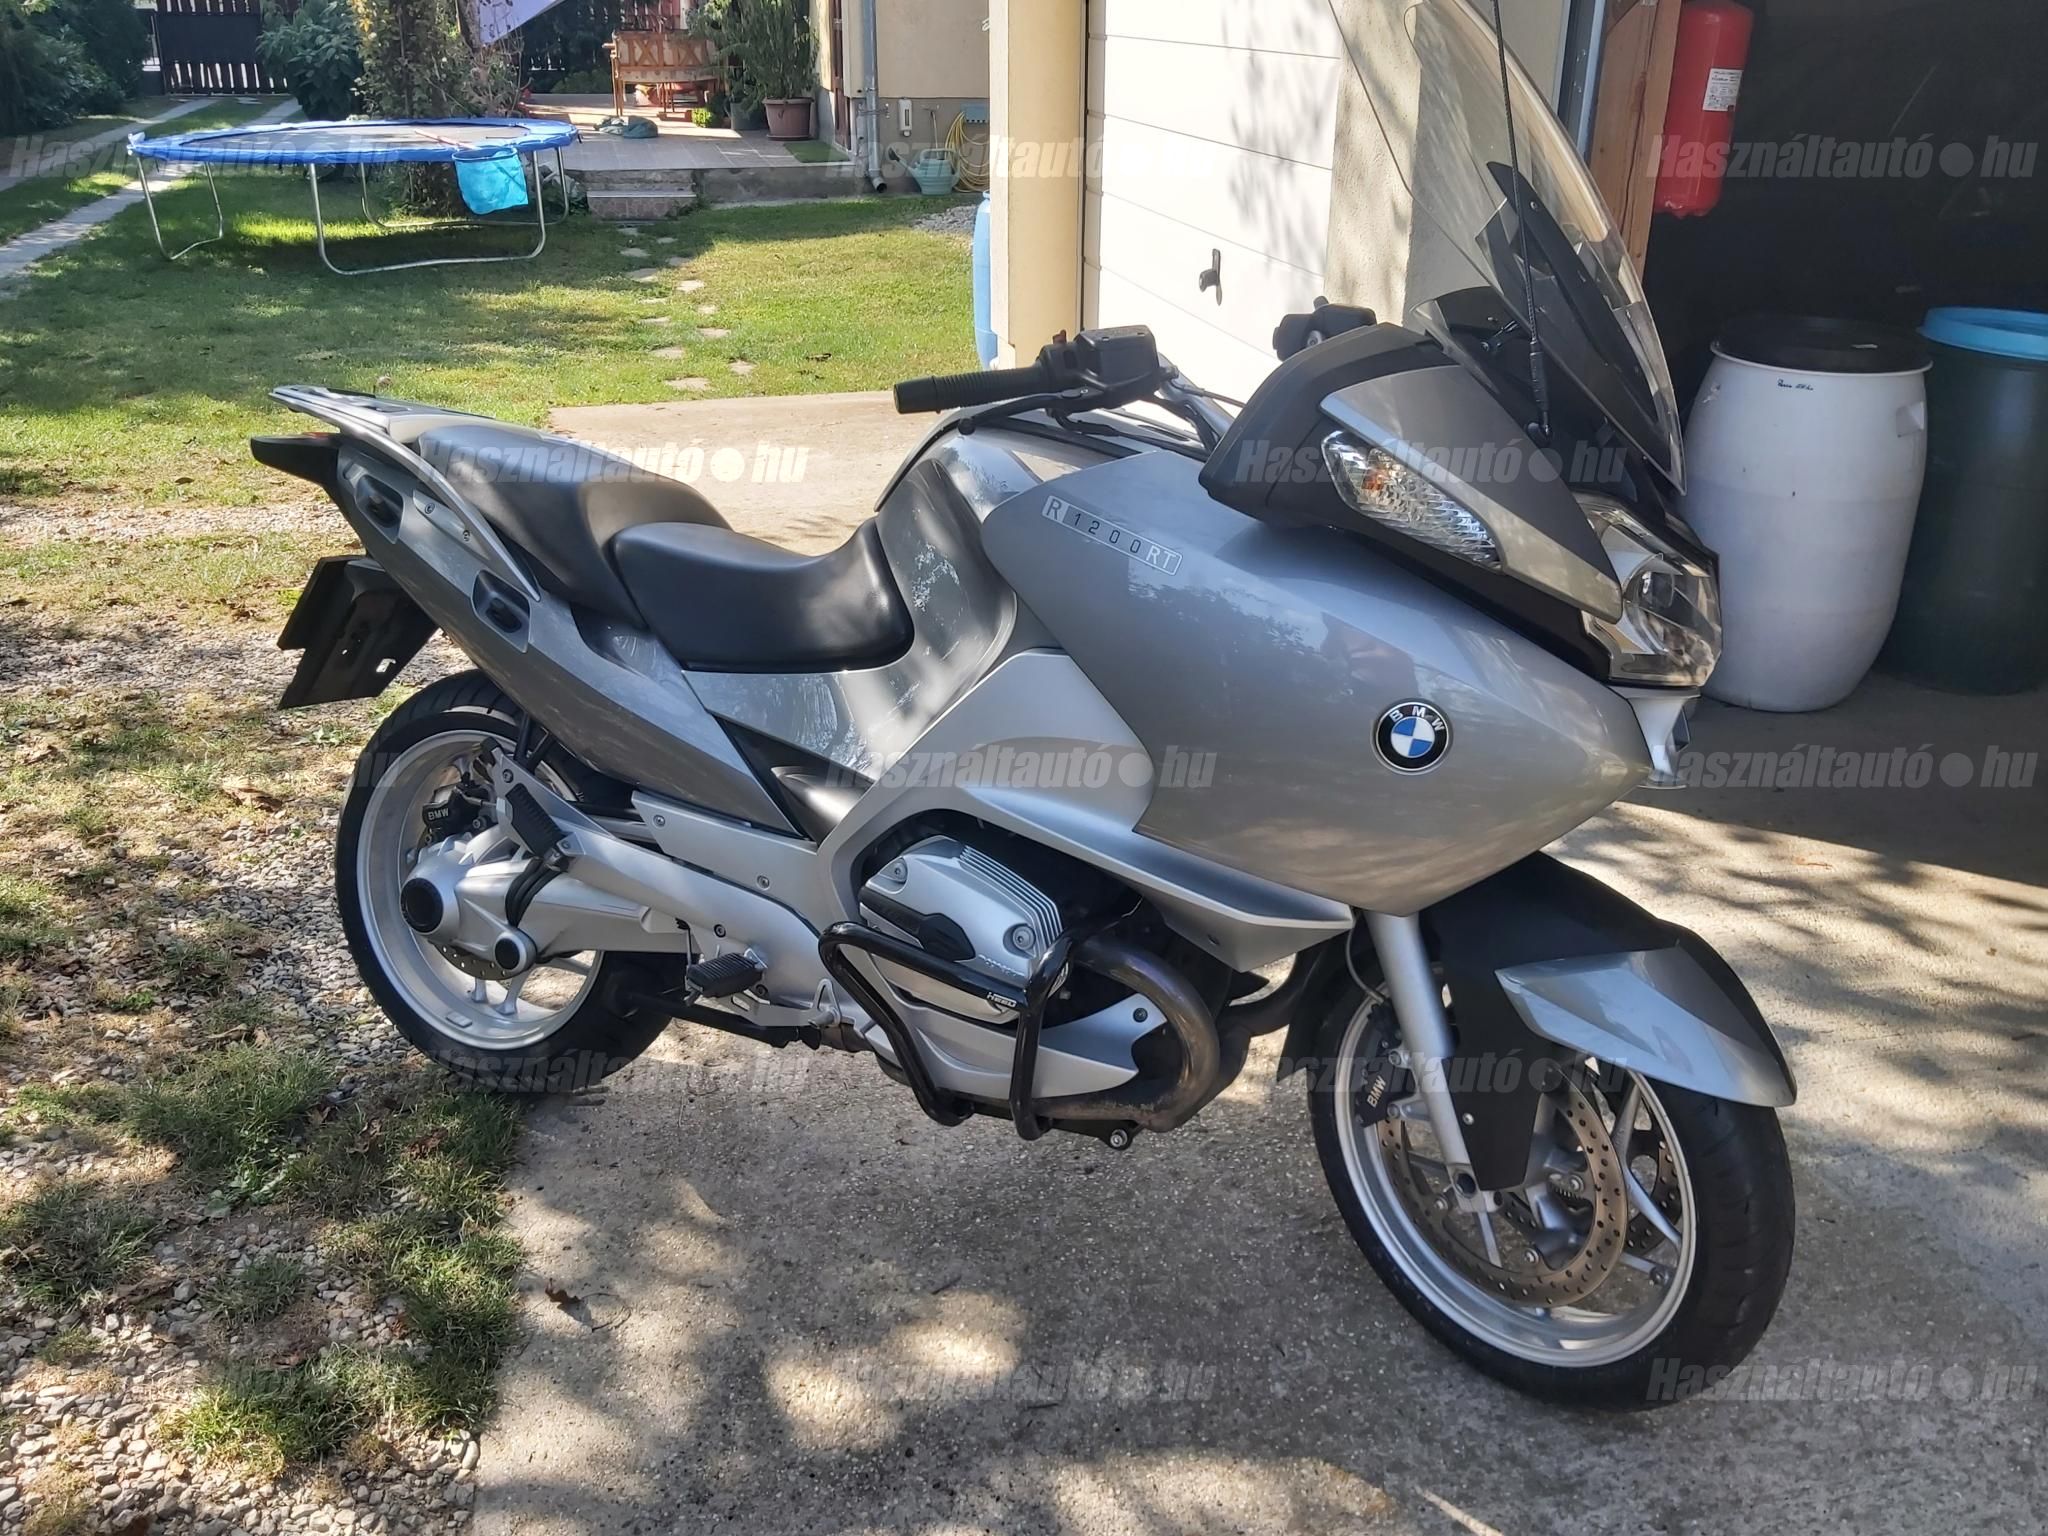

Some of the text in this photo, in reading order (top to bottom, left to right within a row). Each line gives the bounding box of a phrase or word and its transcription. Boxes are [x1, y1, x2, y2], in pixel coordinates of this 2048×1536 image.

[1389, 705, 1445, 731] BMW
[428, 808, 449, 821] BMW
[1366, 1075, 1386, 1108] BMW
